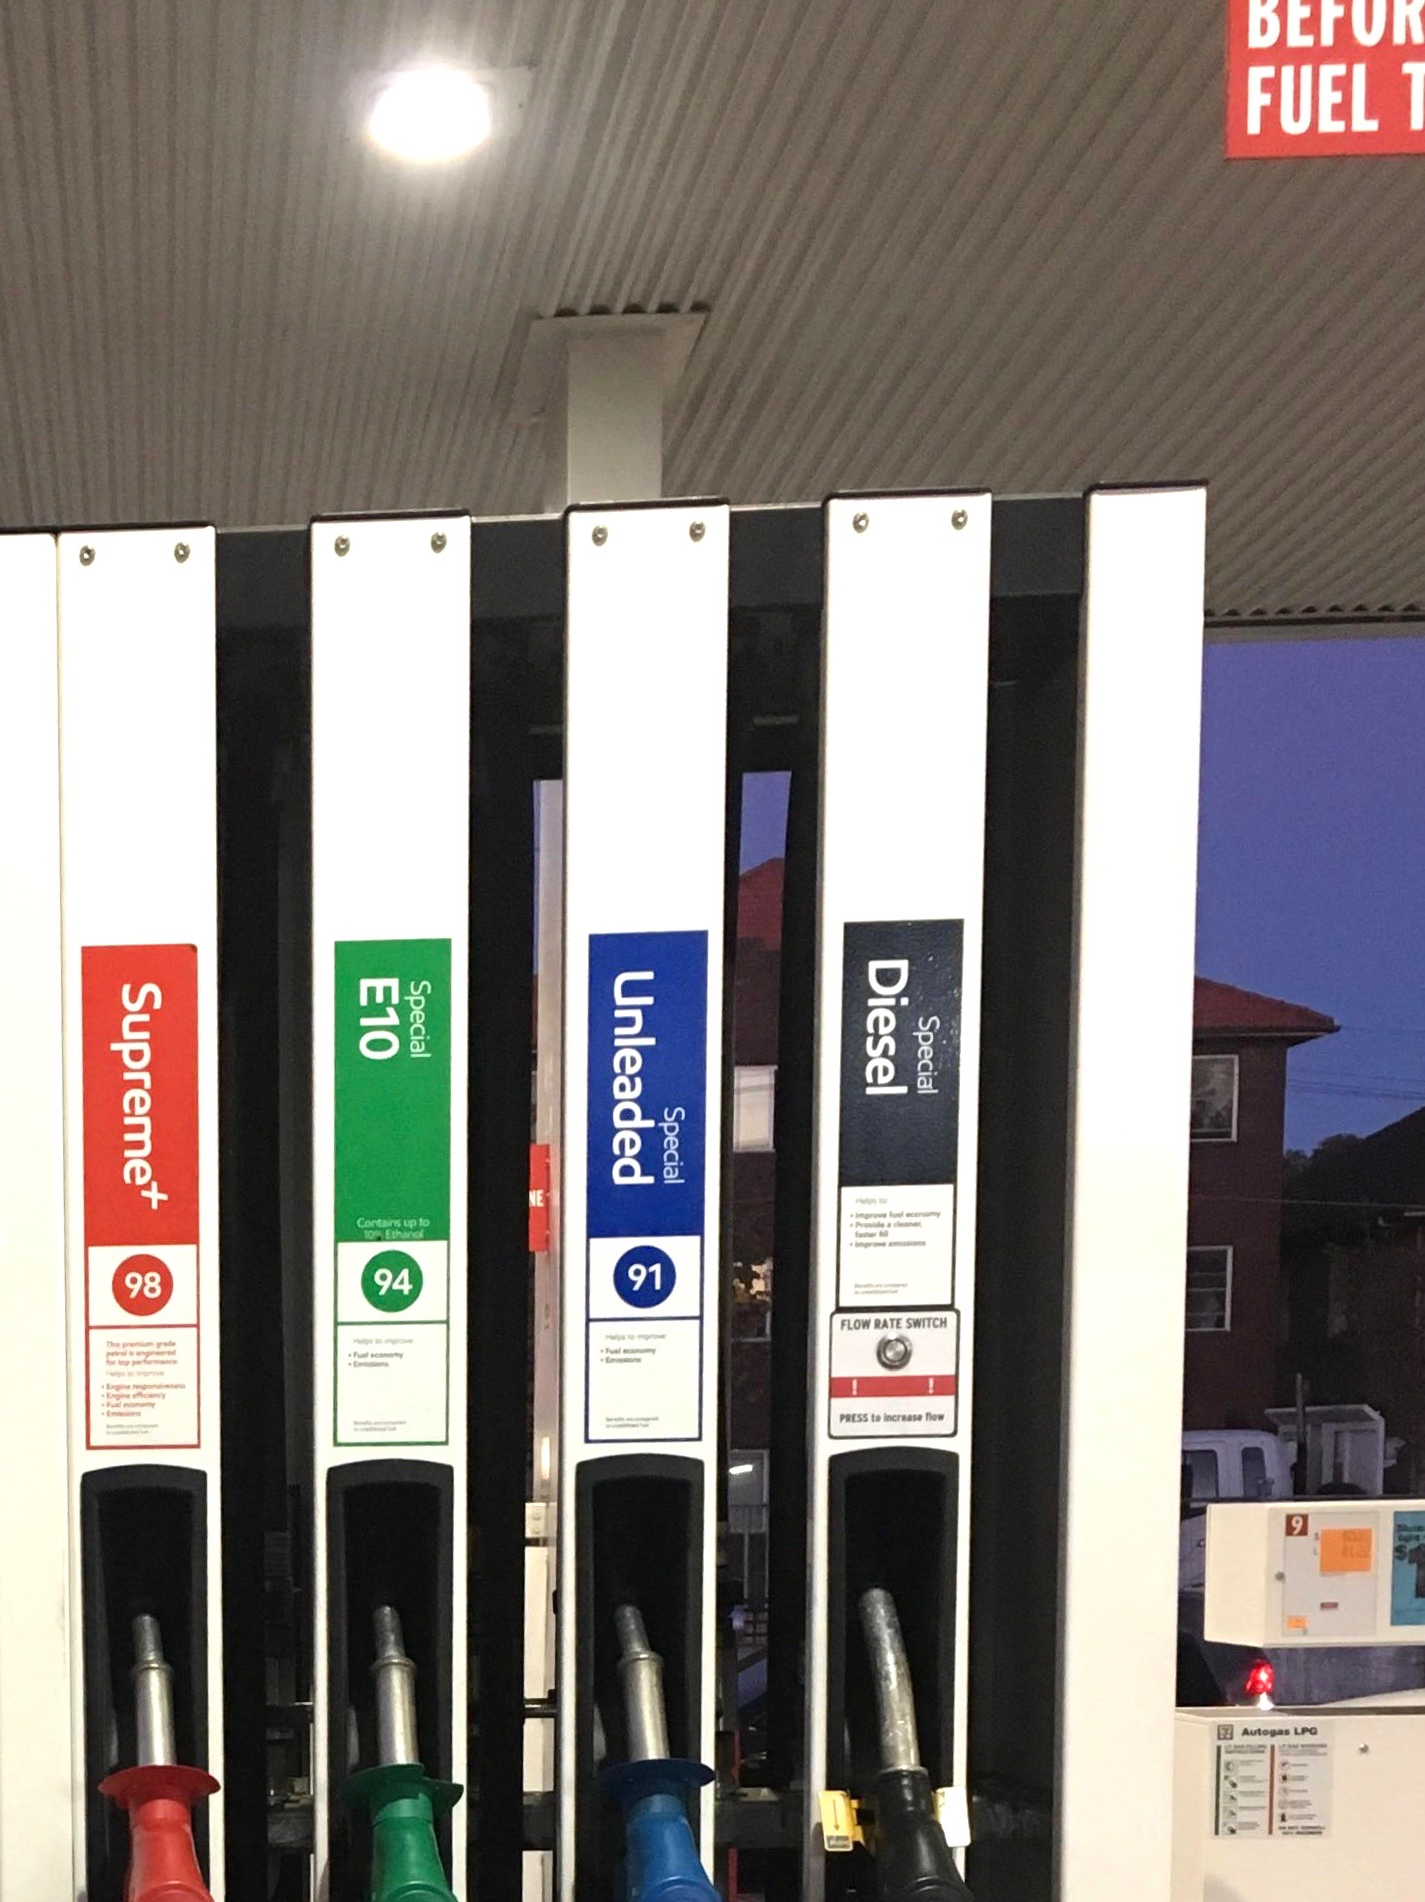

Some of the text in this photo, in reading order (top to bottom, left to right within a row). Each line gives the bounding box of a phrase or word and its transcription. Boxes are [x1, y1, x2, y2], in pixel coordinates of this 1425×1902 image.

[1247, 63, 1379, 135] FUEL
[358, 977, 400, 1061] E10
[403, 980, 432, 1058] Special
[865, 959, 910, 1094] Diesel
[911, 1016, 940, 1093] Special
[612, 971, 656, 1185] Unleaded
[658, 1106, 686, 1184] Special
[356, 1217, 431, 1229] Contains up to
[855, 1210, 941, 1220] Improve fuel economy
[385, 1229, 424, 1239] Ethanol
[854, 1241, 886, 1249] Improve
[374, 1268, 413, 1296] 94
[627, 1263, 663, 1291] 91
[124, 1271, 162, 1300] 98
[840, 1317, 947, 1330] FLOW RATE SWITCH
[122, 1341, 154, 1349] premium
[156, 1340, 176, 1349] grade
[605, 1356, 641, 1364] Emissions
[106, 1383, 131, 1391] Engine
[106, 1392, 131, 1400] Engine
[839, 1411, 945, 1423] PRESS to increase flow
[1292, 1516, 1303, 1535] 9
[1241, 1726, 1318, 1738] Autogas LPG
